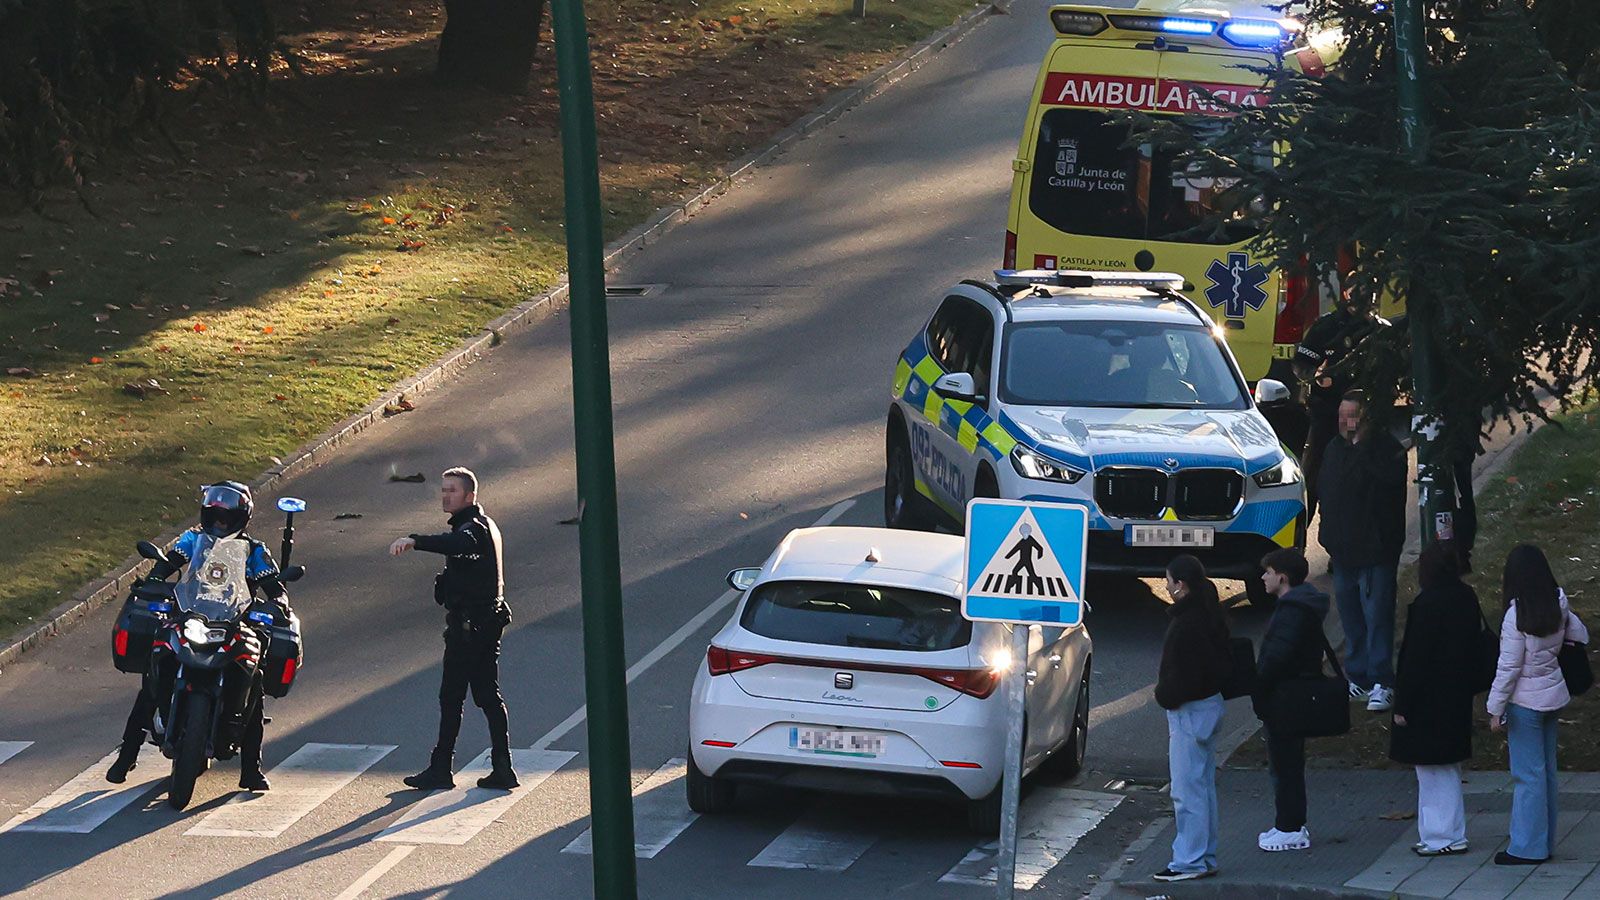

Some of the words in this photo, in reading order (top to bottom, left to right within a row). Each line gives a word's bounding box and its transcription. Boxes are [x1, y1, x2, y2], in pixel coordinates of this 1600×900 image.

[1078, 167, 1109, 179] Junta
[1111, 169, 1127, 180] de
[1048, 176, 1086, 189] Castilla
[1087, 181, 1096, 192] y
[1098, 180, 1125, 191] León
[1061, 256, 1097, 266] CASTILLA
